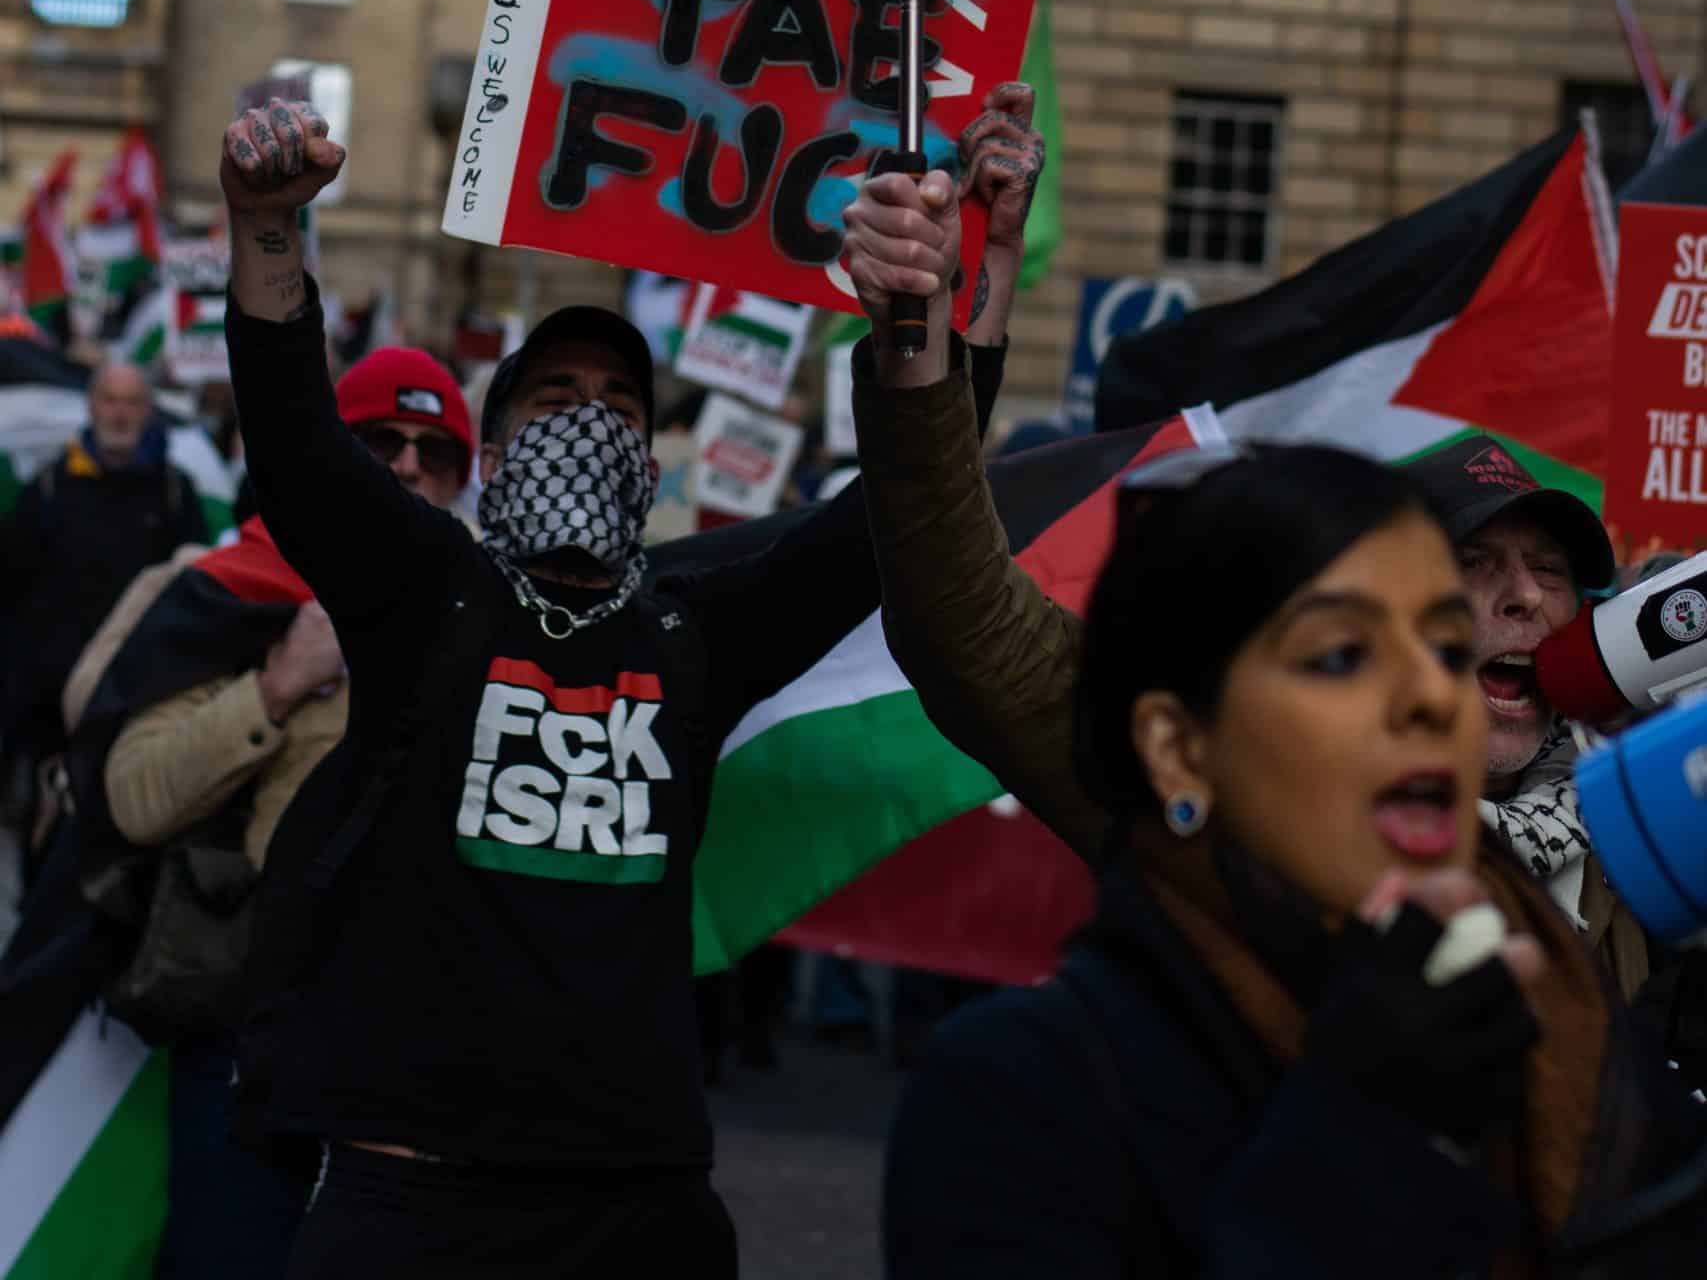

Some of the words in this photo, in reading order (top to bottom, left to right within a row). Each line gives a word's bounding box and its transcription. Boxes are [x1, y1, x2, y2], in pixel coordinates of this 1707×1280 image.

[461, 55, 506, 213] WELCOME
[542, 78, 964, 290] FUC
[1647, 409, 1690, 446] THE
[472, 682, 672, 780] FCK
[456, 761, 668, 856] ISRL
